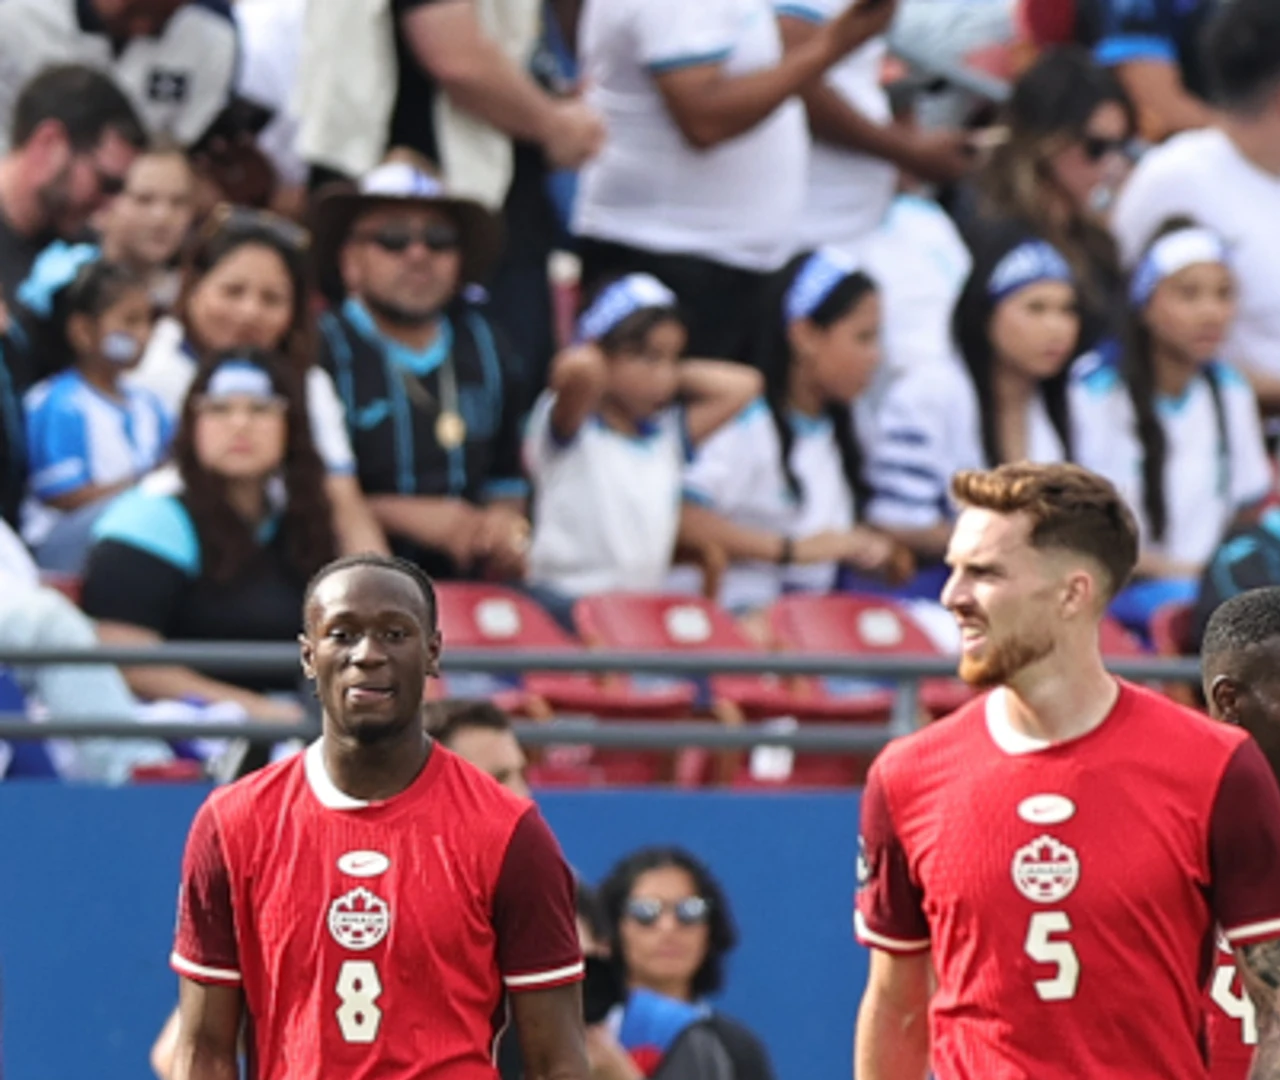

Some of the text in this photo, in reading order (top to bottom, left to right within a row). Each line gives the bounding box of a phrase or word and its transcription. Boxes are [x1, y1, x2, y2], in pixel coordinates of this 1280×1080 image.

[1024, 911, 1079, 1000] 5
[335, 960, 383, 1043] 8
[1210, 965, 1259, 1045] 4
